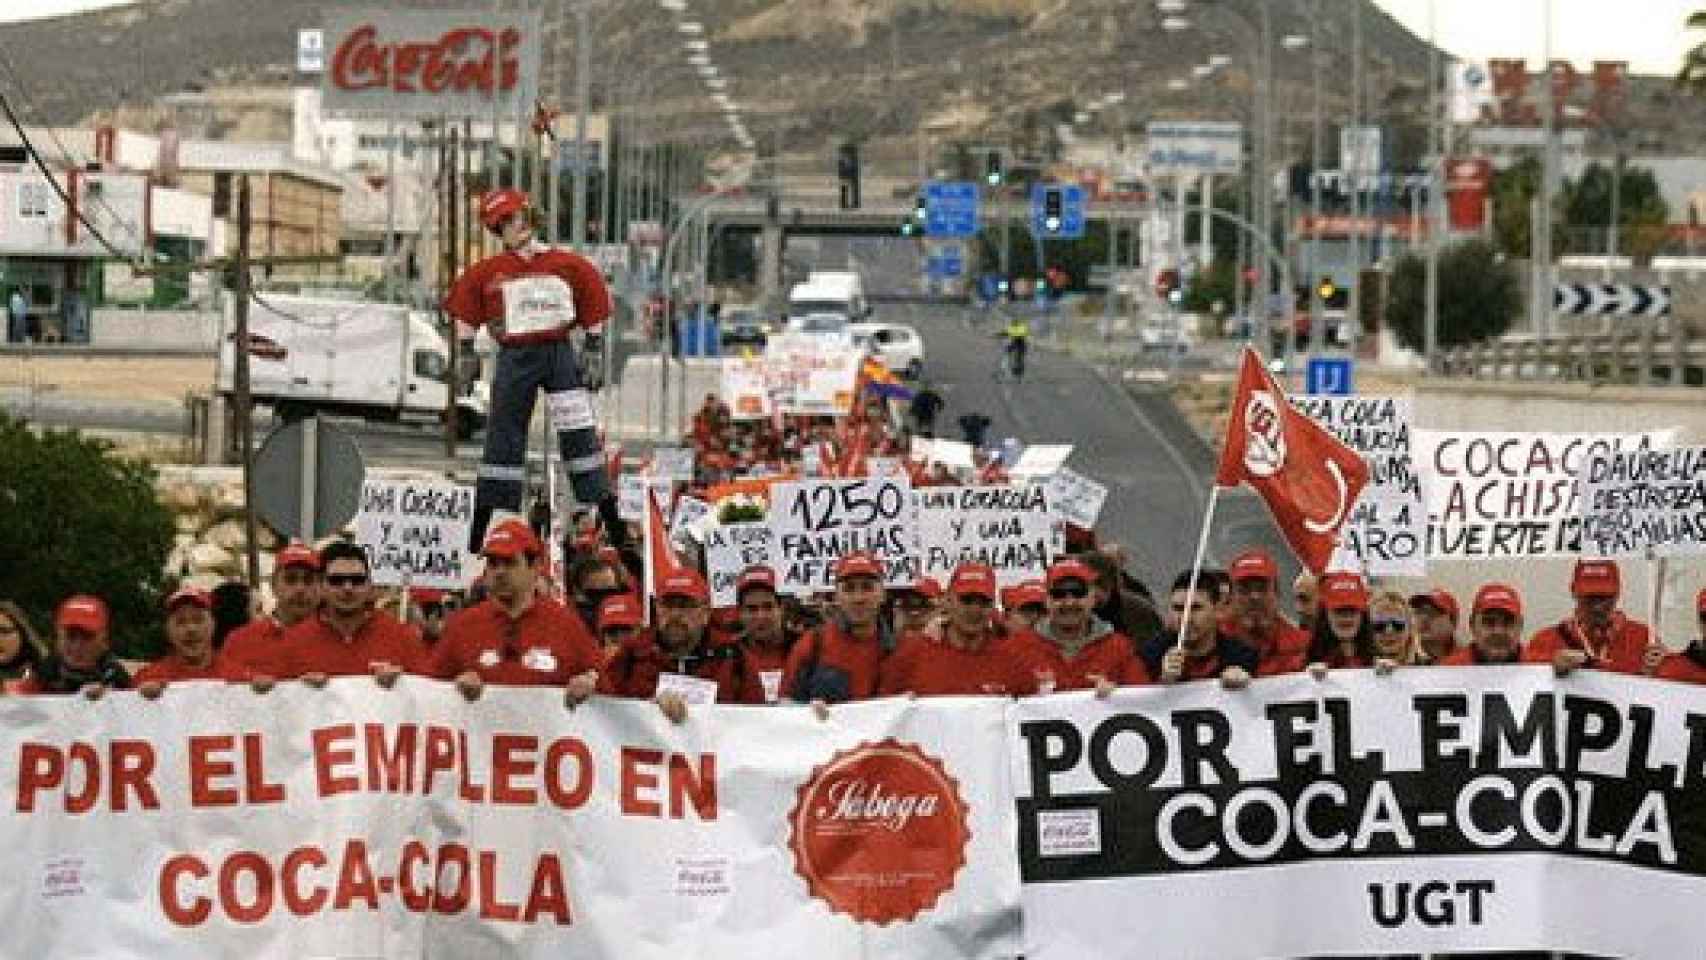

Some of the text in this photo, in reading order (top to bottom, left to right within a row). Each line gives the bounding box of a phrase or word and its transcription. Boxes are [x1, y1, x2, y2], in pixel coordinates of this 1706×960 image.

[790, 482, 903, 532] 1250
[15, 723, 718, 822] POR EL EMPLEO EN
[1020, 708, 1241, 798] POR
[1265, 698, 1383, 780] EL
[1156, 773, 1678, 866] COCA-COLA
[159, 839, 571, 926] COCA-COLA
[1367, 879, 1495, 929] UGT
